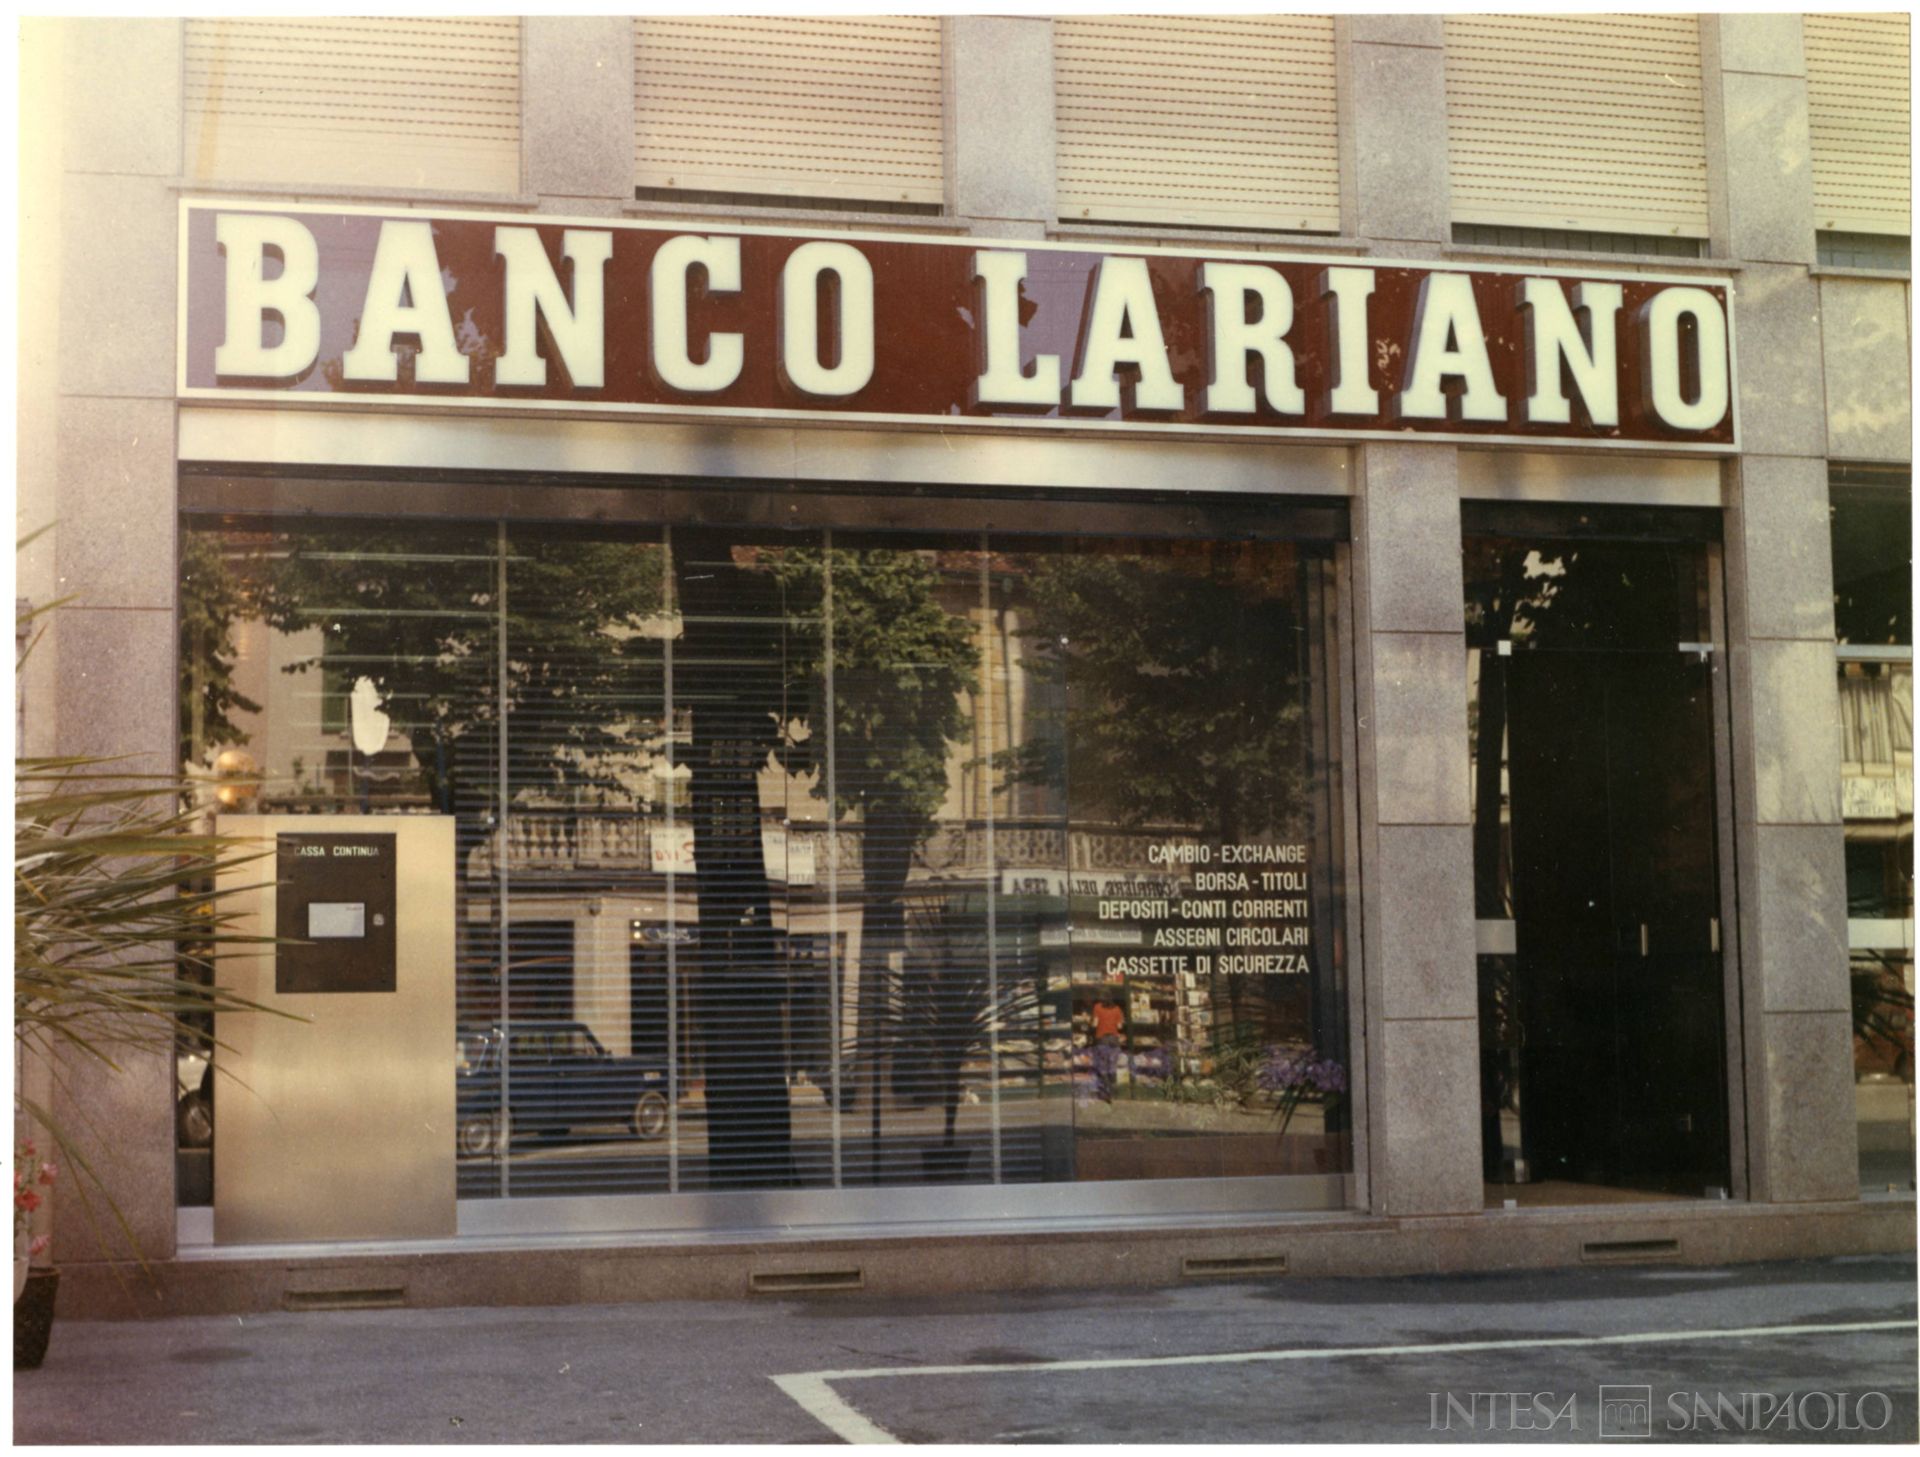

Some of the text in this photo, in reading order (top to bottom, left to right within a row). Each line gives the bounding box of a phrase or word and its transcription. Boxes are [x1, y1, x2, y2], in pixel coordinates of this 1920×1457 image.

[215, 213, 1728, 432] BANCO LARIANO
[293, 846, 380, 857] CASSA CONTINUA
[1232, 900, 1308, 918] CORRENTI
[1153, 928, 1221, 947] ASSEGNI
[1226, 927, 1309, 946] CIRCOLARI
[1105, 955, 1309, 976] CASSETTE DI SICUREZZA
